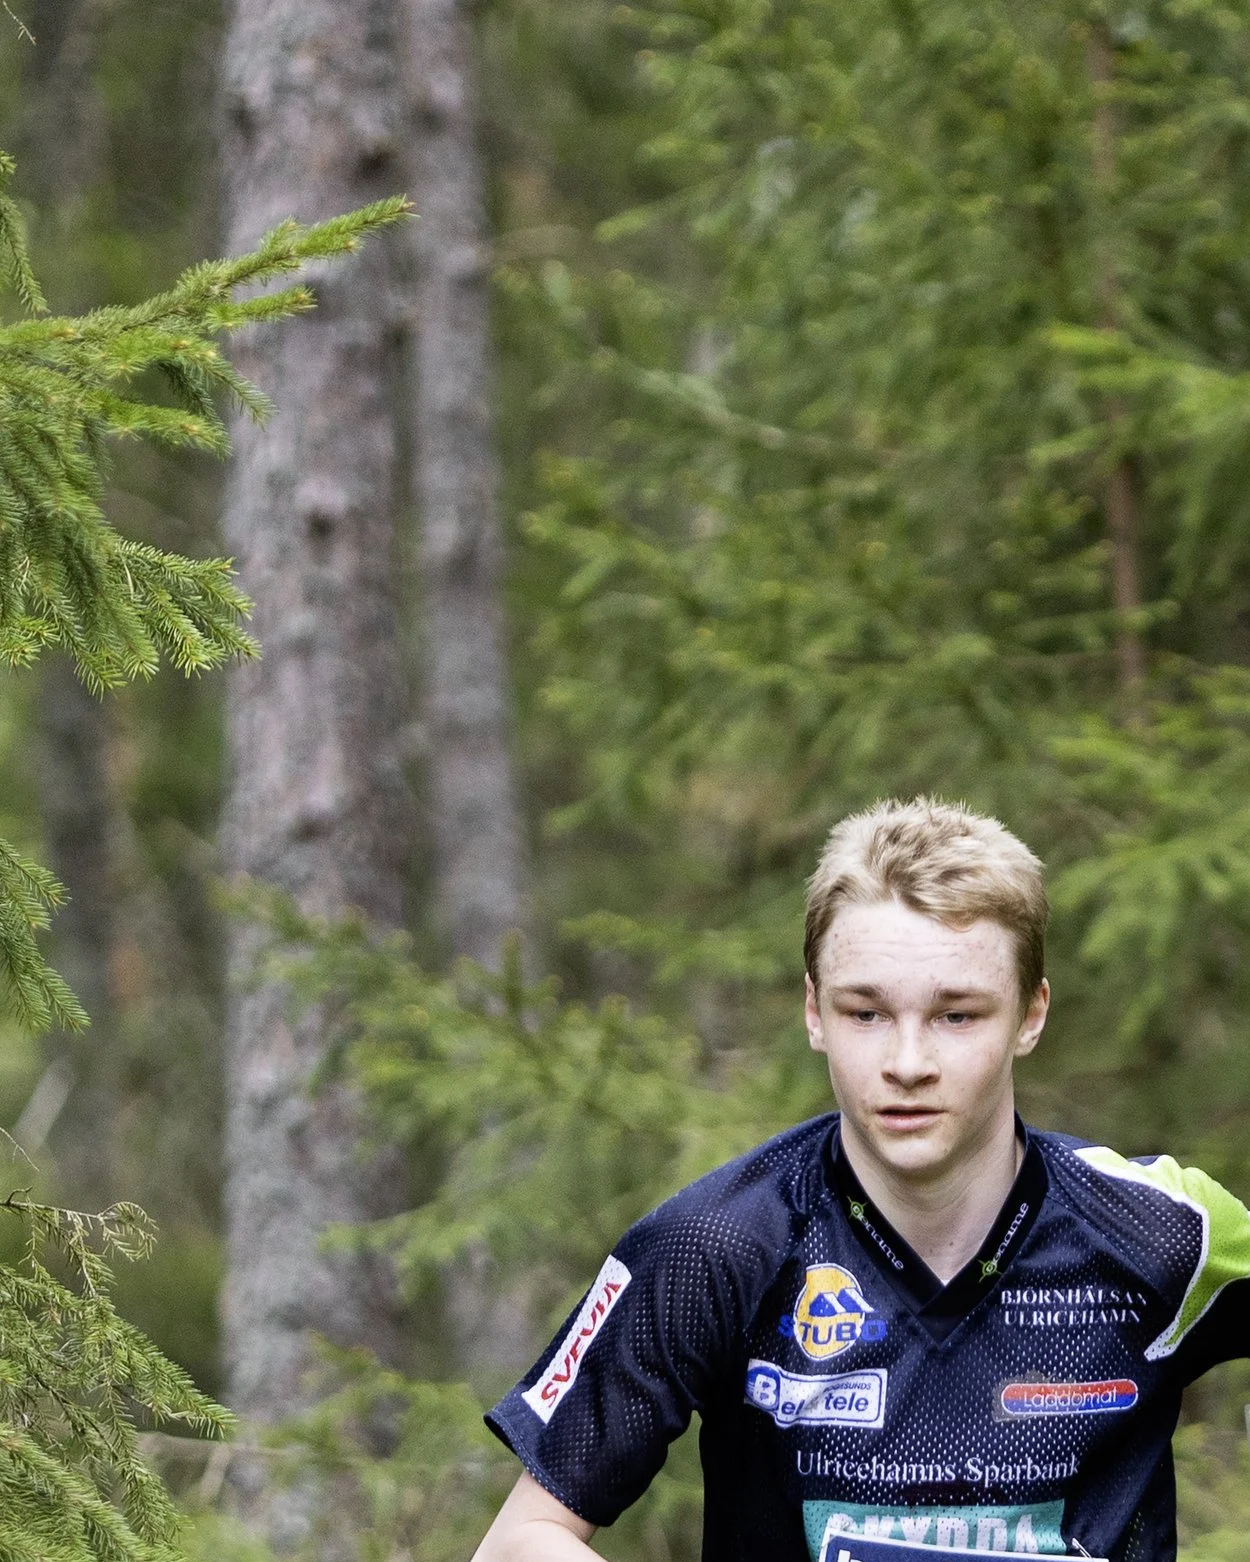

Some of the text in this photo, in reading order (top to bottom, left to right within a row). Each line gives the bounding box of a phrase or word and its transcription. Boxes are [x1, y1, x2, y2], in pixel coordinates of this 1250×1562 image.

[778, 1314, 887, 1344] STUBO
[540, 1282, 622, 1408] SVEVIA
[824, 1392, 870, 1412] tele
[1024, 1387, 1117, 1407] Laddomat
[797, 1449, 1080, 1488] Ulricehamns Sparbank
